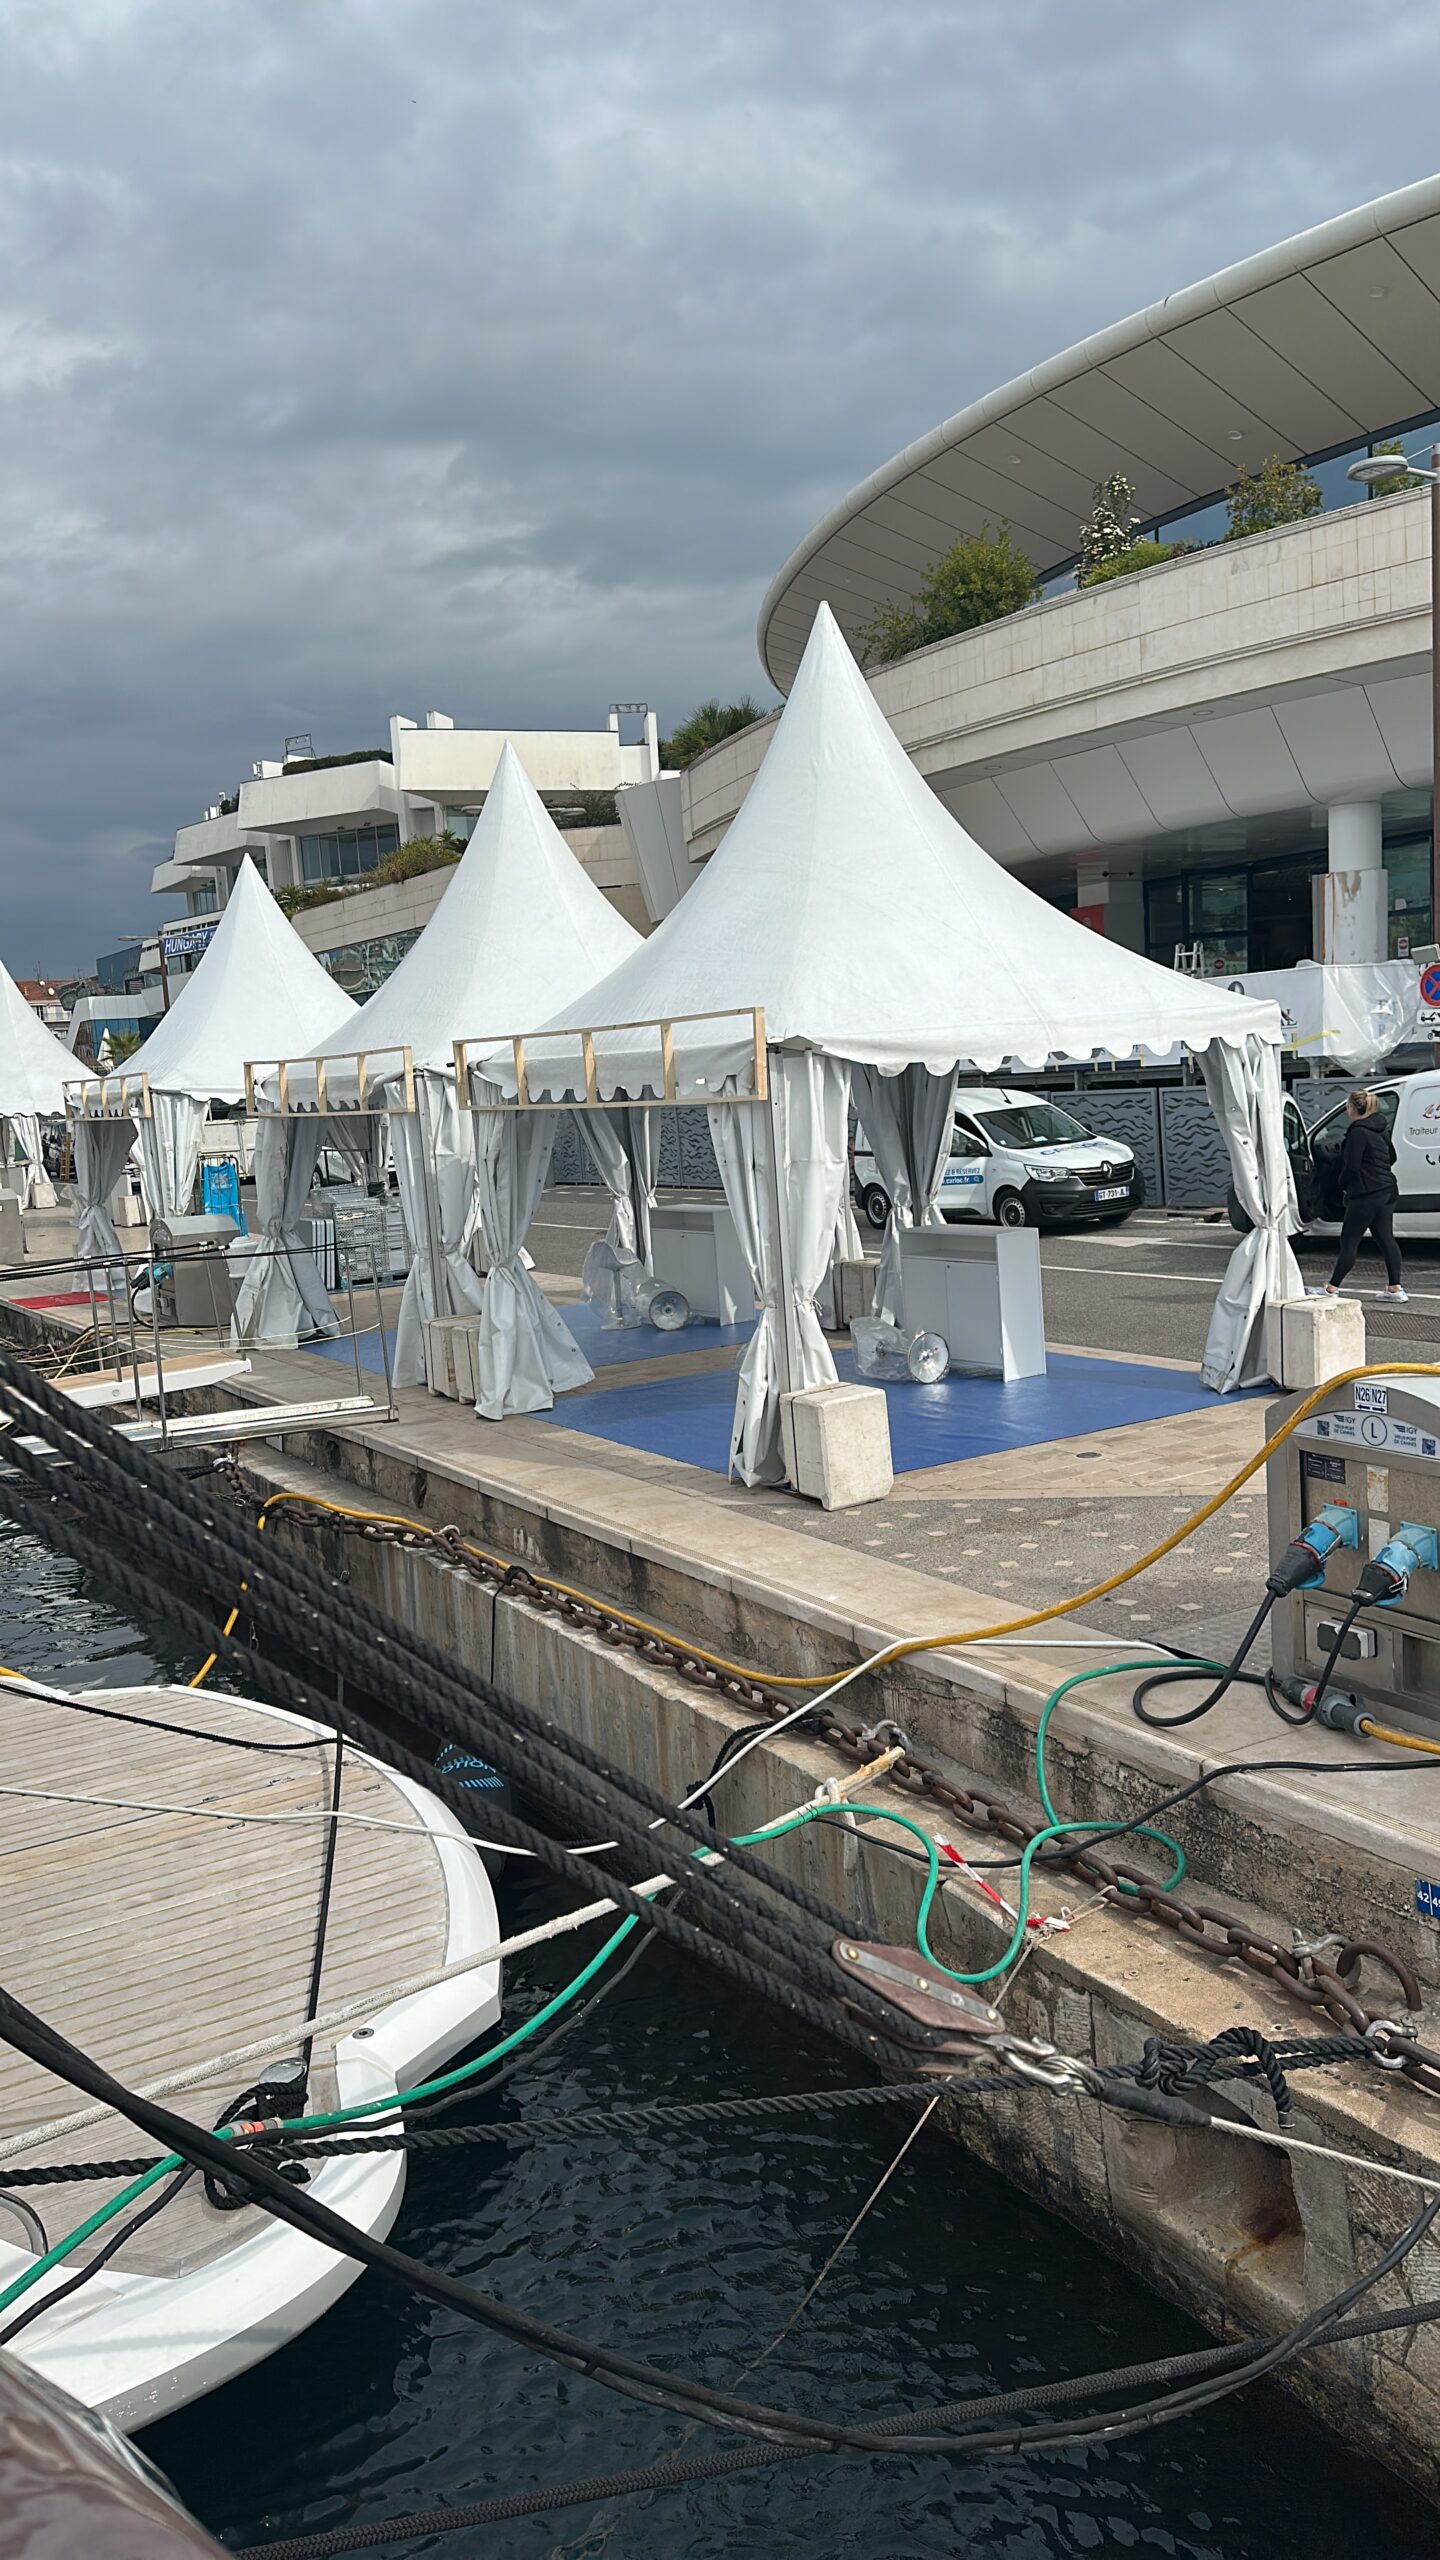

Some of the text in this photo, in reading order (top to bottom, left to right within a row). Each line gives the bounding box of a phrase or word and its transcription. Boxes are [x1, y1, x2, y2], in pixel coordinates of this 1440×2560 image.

[165, 931, 208, 953] HUNGARY
[1409, 1127, 1438, 1136] Traiteur
[1355, 1386, 1387, 1404] N26 N27
[1345, 1416, 1355, 1424] IGY
[1371, 1422, 1377, 1439] L
[1406, 1427, 1418, 1435] IGY
[442, 1756, 497, 1774] OTION
[1417, 1890, 1430, 1904] 42
